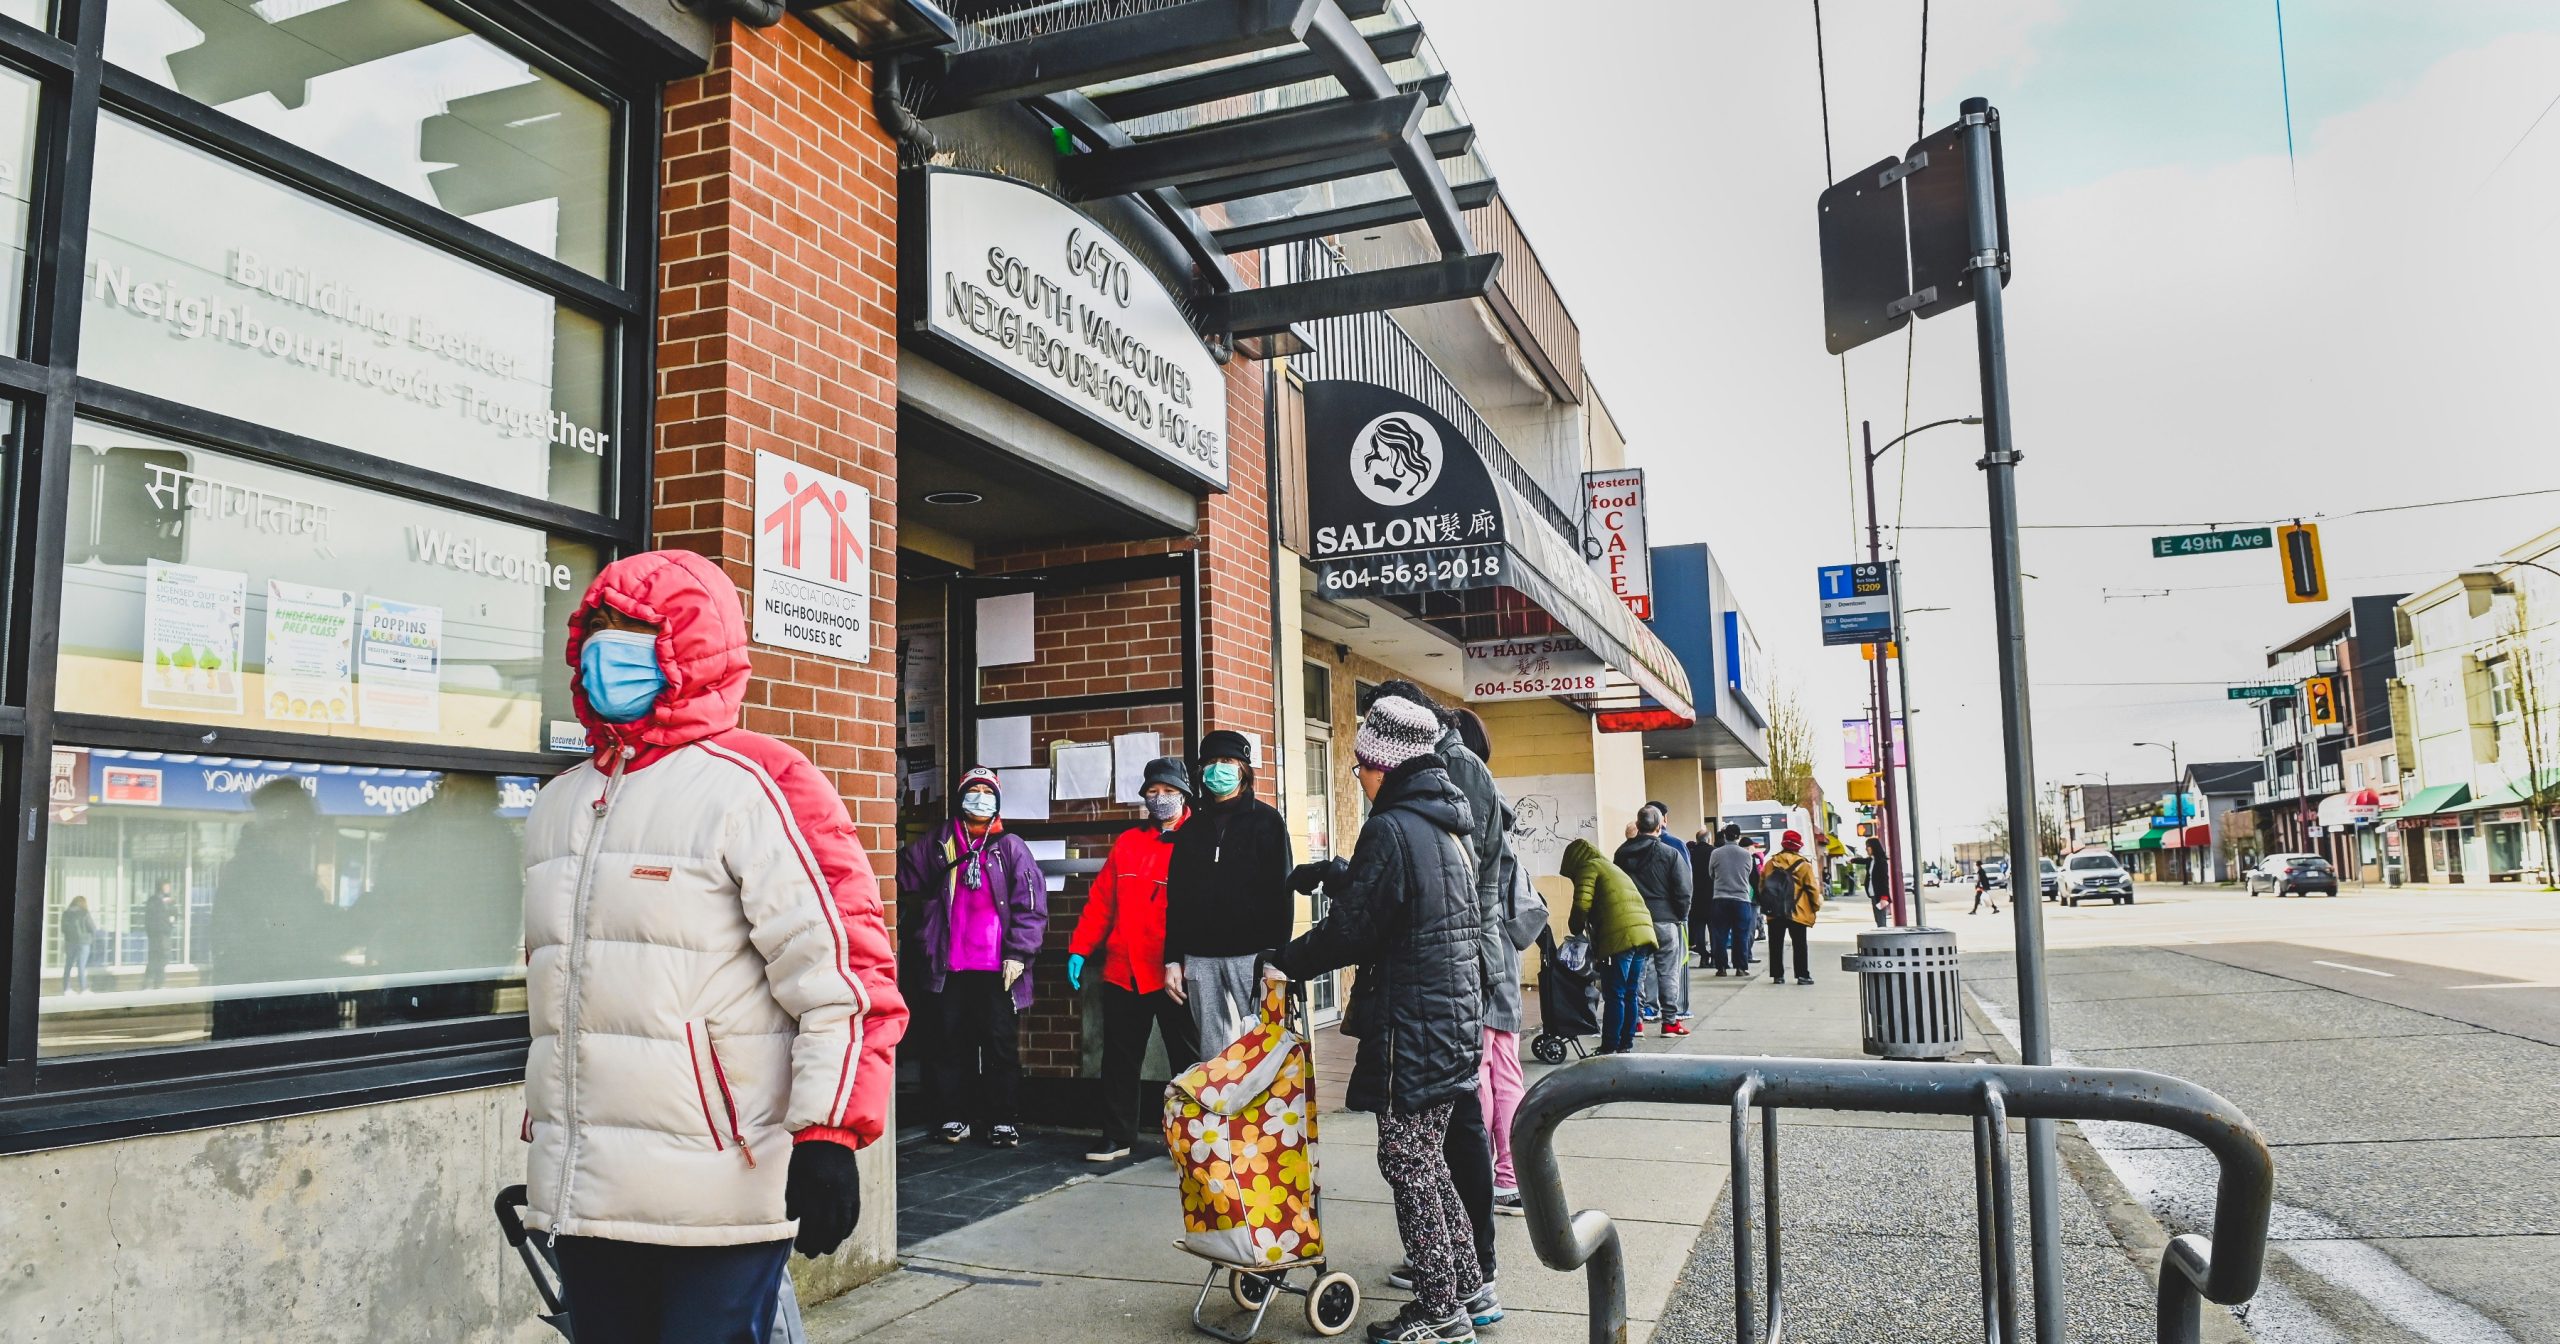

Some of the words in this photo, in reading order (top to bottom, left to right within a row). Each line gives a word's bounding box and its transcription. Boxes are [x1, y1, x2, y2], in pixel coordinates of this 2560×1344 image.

[1067, 228, 1132, 308] 6470
[236, 247, 399, 345] Building
[418, 313, 525, 380] Better
[986, 246, 1073, 332] SOUTH
[1080, 303, 1193, 408] VANCOUVER
[95, 258, 449, 407] Neighbourhoods
[465, 384, 609, 456] Together
[945, 271, 1152, 430] NEIGHBOURHOOD
[1159, 403, 1219, 468] HOUSE
[1587, 478, 1640, 489] western
[1591, 492, 1637, 509] food
[1316, 515, 1438, 554] SALON
[2161, 540, 2173, 554] E
[2181, 537, 2224, 552] 49th
[2231, 533, 2264, 547] Ave
[415, 524, 571, 591] Welcome
[1605, 511, 1628, 595] CAFE
[1326, 556, 1500, 590] 604-563-2018
[1824, 570, 1844, 594] T
[156, 585, 194, 599] LICENSED
[198, 591, 215, 600] OUT
[770, 579, 840, 608] ASSOCIATION
[843, 597, 856, 611] OF
[1857, 583, 1880, 592] 51209
[155, 594, 189, 607] SCHOOL
[275, 608, 346, 627] KINDERGARTEN
[373, 615, 427, 635] POPPINS
[765, 598, 860, 632] NEIGHBOURHOOD
[282, 621, 308, 634] PREP
[310, 625, 338, 638] CLASS
[364, 629, 437, 648] PRESCHOOL
[784, 622, 827, 645] HOUSES
[829, 633, 843, 647] BC
[1466, 646, 1488, 659] VL
[1493, 642, 1537, 657] HAIR
[1542, 639, 1587, 653] SALO
[1474, 676, 1595, 696] 604-563-2018
[2232, 689, 2239, 698] E
[2243, 688, 2268, 697] 49th
[2272, 687, 2291, 695] Ave
[551, 735, 576, 746] secured
[577, 737, 585, 747] by
